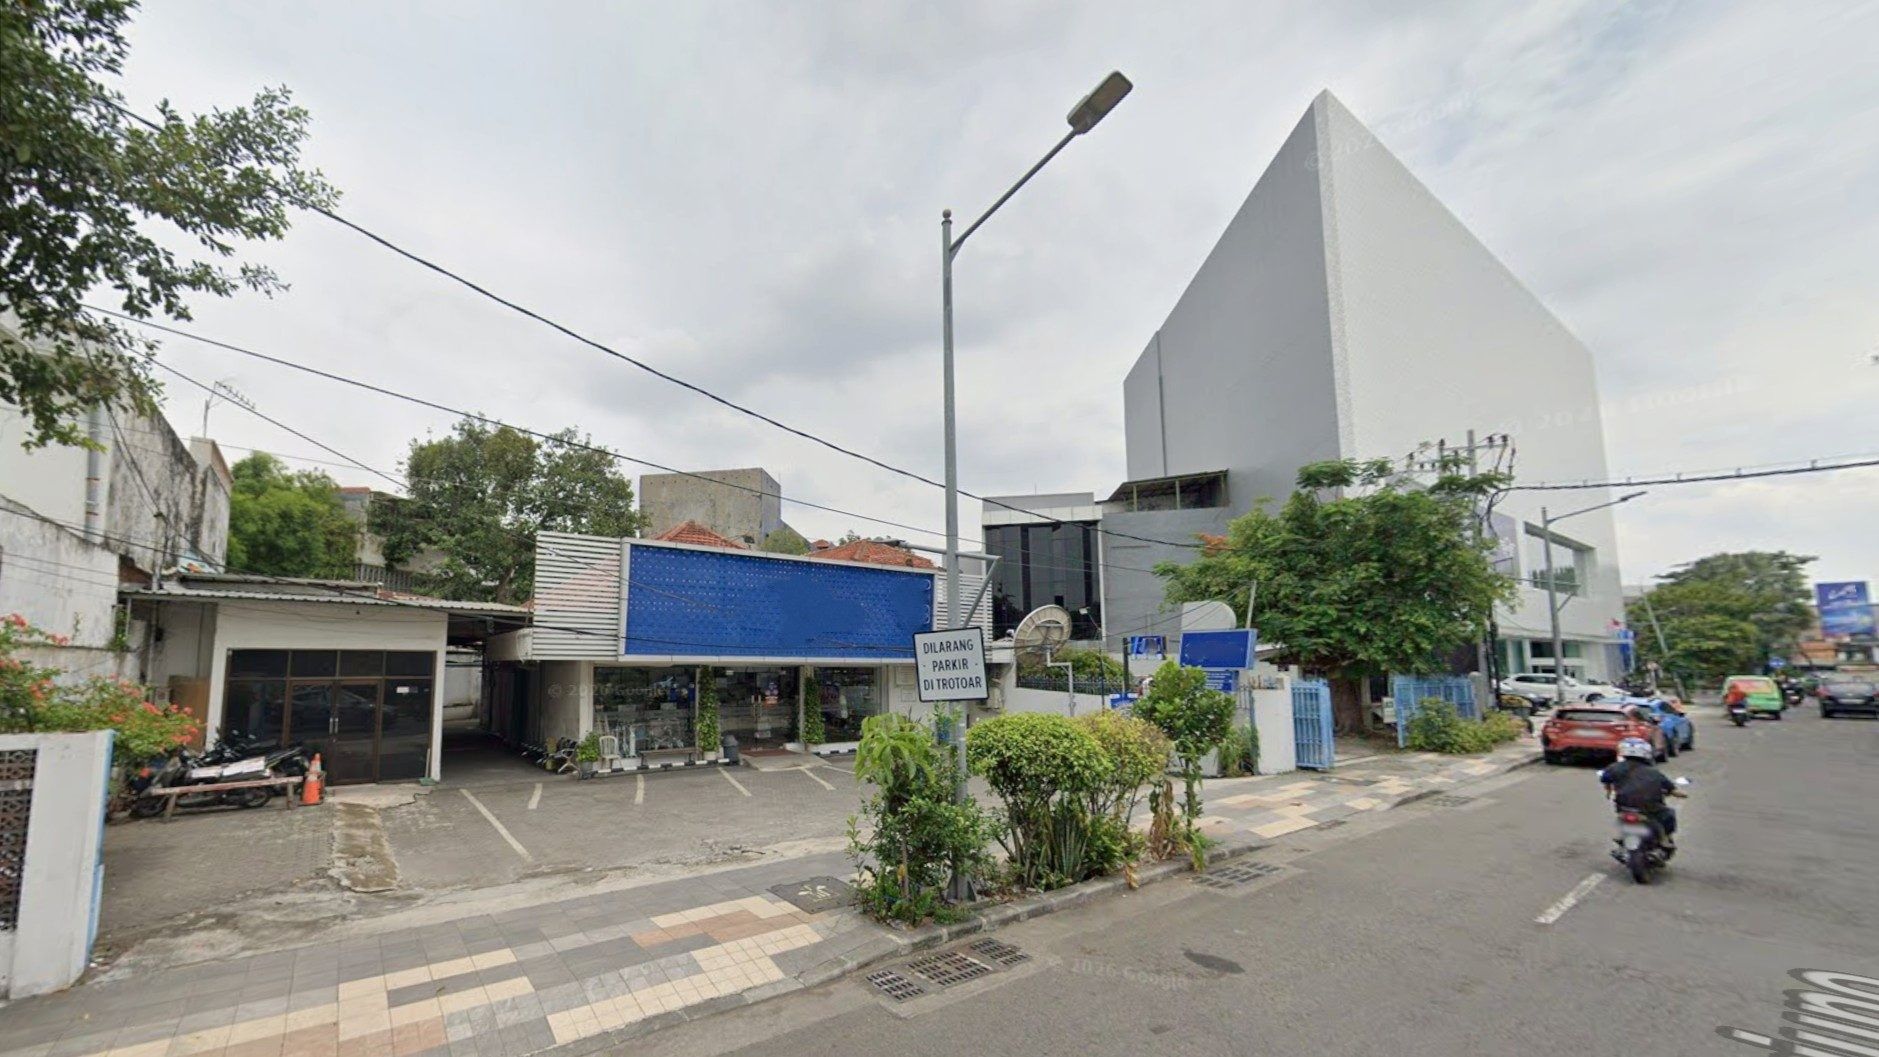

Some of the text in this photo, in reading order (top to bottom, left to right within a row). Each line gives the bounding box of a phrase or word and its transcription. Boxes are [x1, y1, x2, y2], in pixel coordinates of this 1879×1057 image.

[923, 639, 974, 654] DILARANG
[932, 658, 969, 672] PARKIR
[923, 676, 982, 691] DI TROTOAR
